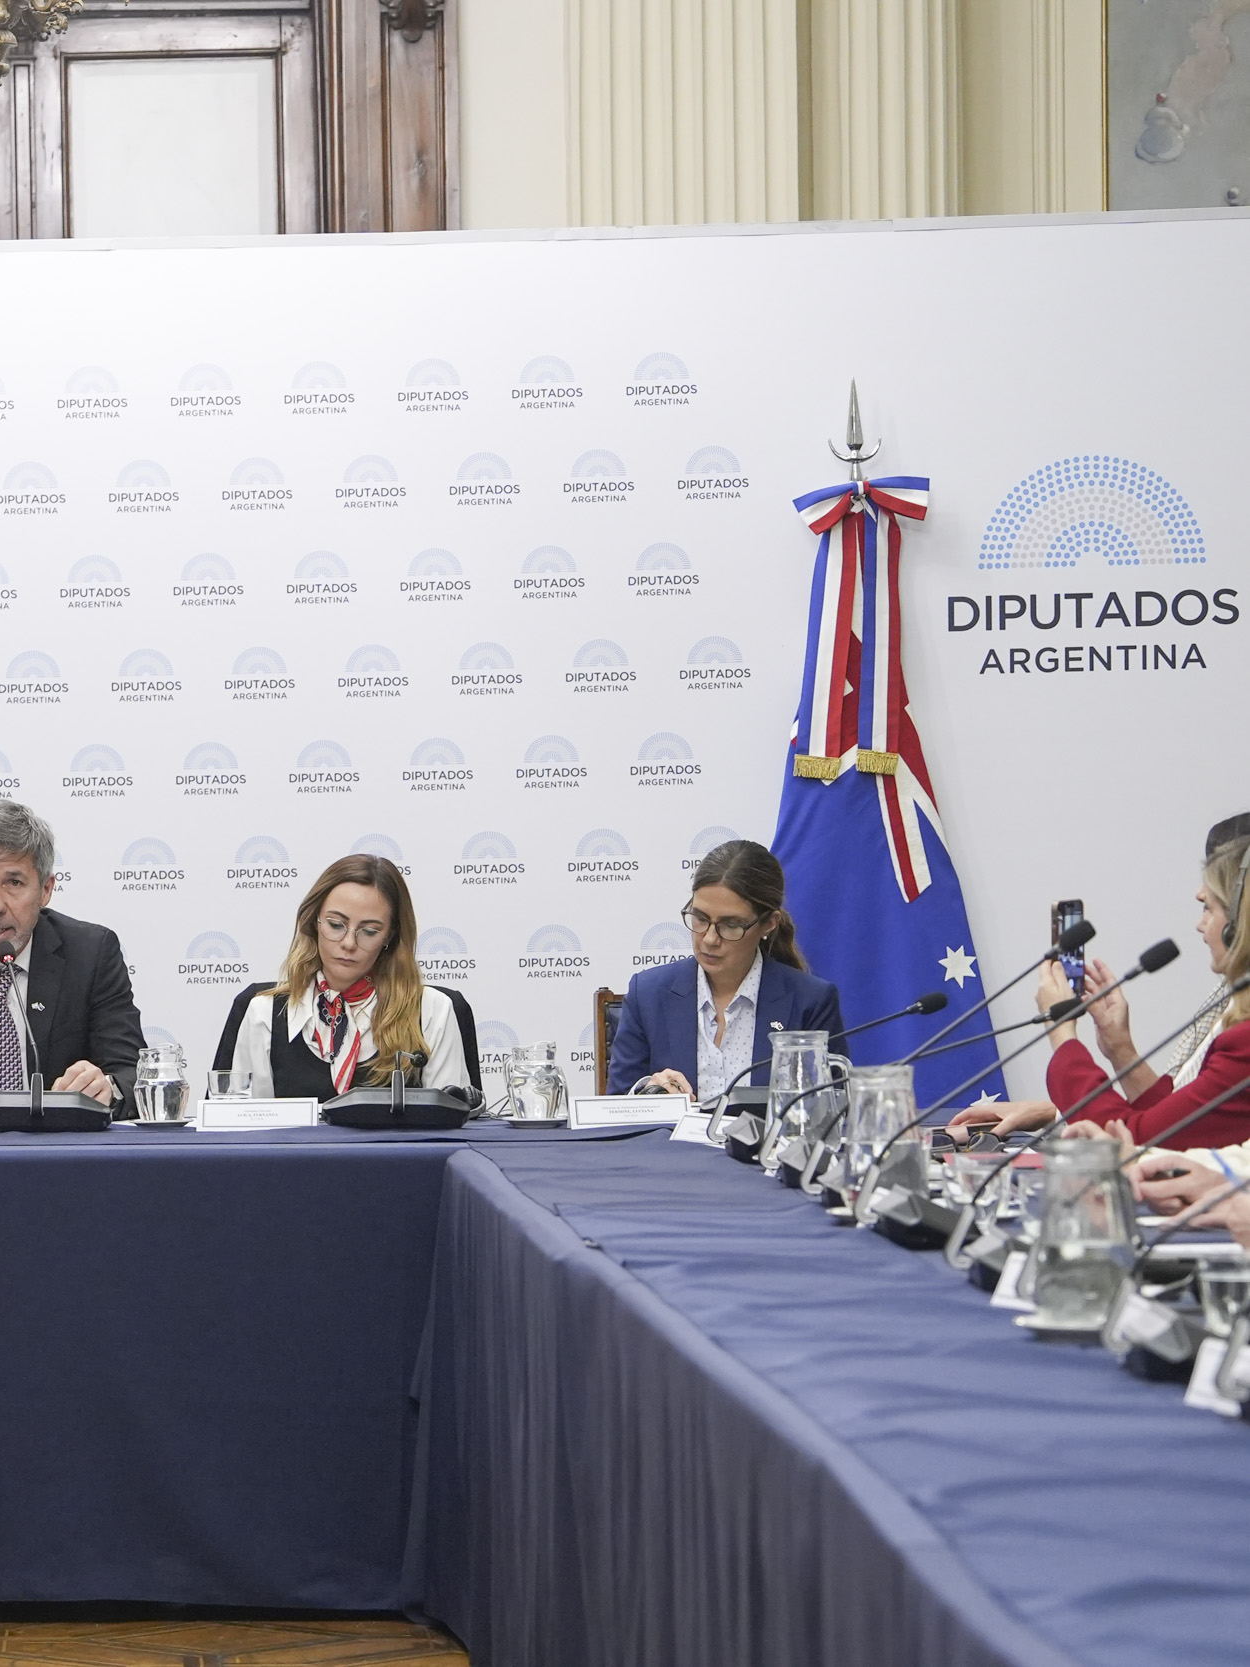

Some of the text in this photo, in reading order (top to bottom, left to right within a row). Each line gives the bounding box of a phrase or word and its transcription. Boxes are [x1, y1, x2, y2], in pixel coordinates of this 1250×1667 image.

[397, 390, 469, 402] DIPUTADOS
[511, 387, 584, 400] DIPUTADOS
[625, 384, 698, 397] DIPUTADOS
[283, 393, 355, 405] DIPUTADOS
[519, 400, 576, 410] ARGENTINA
[633, 397, 690, 407] ARGENTINA
[291, 406, 348, 415] ARGENTINA
[405, 403, 461, 412] ARGENTINA
[563, 481, 635, 493] DIPUTADOS
[677, 477, 750, 490] DIPUTADOS
[221, 489, 293, 501] DIPUTADOS
[335, 486, 407, 499] DIPUTADOS
[449, 484, 521, 496] DIPUTADOS
[685, 491, 742, 500] ARGENTINA
[108, 491, 180, 503] DIPUTADOS
[457, 497, 513, 506] ARGENTINA
[571, 494, 627, 503] ARGENTINA
[116, 505, 172, 513] ARGENTINA
[229, 502, 285, 511] ARGENTINA
[343, 500, 399, 509] ARGENTINA
[399, 580, 472, 592] DIPUTADOS
[513, 577, 586, 590] DIPUTADOS
[627, 574, 700, 587] DIPUTADOS
[59, 587, 131, 599] DIPUTADOS
[172, 584, 245, 597] DIPUTADOS
[286, 582, 358, 594] DIPUTADOS
[635, 587, 692, 597] ARGENTINA
[294, 596, 350, 605] ARGENTINA
[407, 593, 464, 602] ARGENTINA
[521, 590, 578, 600] ARGENTINA
[67, 600, 123, 609] ARGENTINA
[181, 598, 236, 607] ARGENTINA
[947, 588, 1240, 633] DIPUTADOS
[979, 643, 1207, 675] ARGENTINA
[451, 673, 523, 686] DIPUTADOS
[565, 670, 637, 683] DIPUTADOS
[679, 667, 752, 680] DIPUTADOS
[110, 680, 183, 692] DIPUTADOS
[224, 678, 296, 690] DIPUTADOS
[337, 676, 409, 688] DIPUTADOS
[687, 681, 744, 690] ARGENTINA
[345, 689, 402, 698] ARGENTINA
[459, 687, 515, 696] ARGENTINA
[573, 684, 629, 693] ARGENTINA
[5, 696, 61, 705] ARGENTINA
[118, 694, 175, 703] ARGENTINA
[232, 692, 288, 700] ARGENTINA
[402, 769, 474, 781] DIPUTADOS
[515, 767, 588, 779] DIPUTADOS
[629, 764, 702, 776] DIPUTADOS
[62, 776, 134, 788] DIPUTADOS
[175, 774, 247, 786] DIPUTADOS
[288, 771, 360, 784] DIPUTADOS
[637, 777, 694, 787] ARGENTINA
[296, 785, 353, 794] ARGENTINA
[410, 783, 466, 792] ARGENTINA
[523, 780, 580, 789] ARGENTINA
[70, 789, 126, 798] ARGENTINA
[183, 787, 239, 796] ARGENTINA
[453, 863, 526, 875] DIPUTADOS
[567, 860, 640, 873] DIPUTADOS
[113, 869, 185, 881] DIPUTADOS
[226, 867, 299, 879] DIPUTADOS
[575, 874, 632, 883] ARGENTINA
[234, 881, 290, 889] ARGENTINA
[461, 876, 518, 885] ARGENTINA
[121, 883, 177, 891] ARGENTINA
[518, 956, 591, 968] DIPUTADOS
[178, 963, 250, 975] DIPUTADOS
[526, 969, 583, 979] ARGENTINA
[186, 976, 242, 985] ARGENTINA
